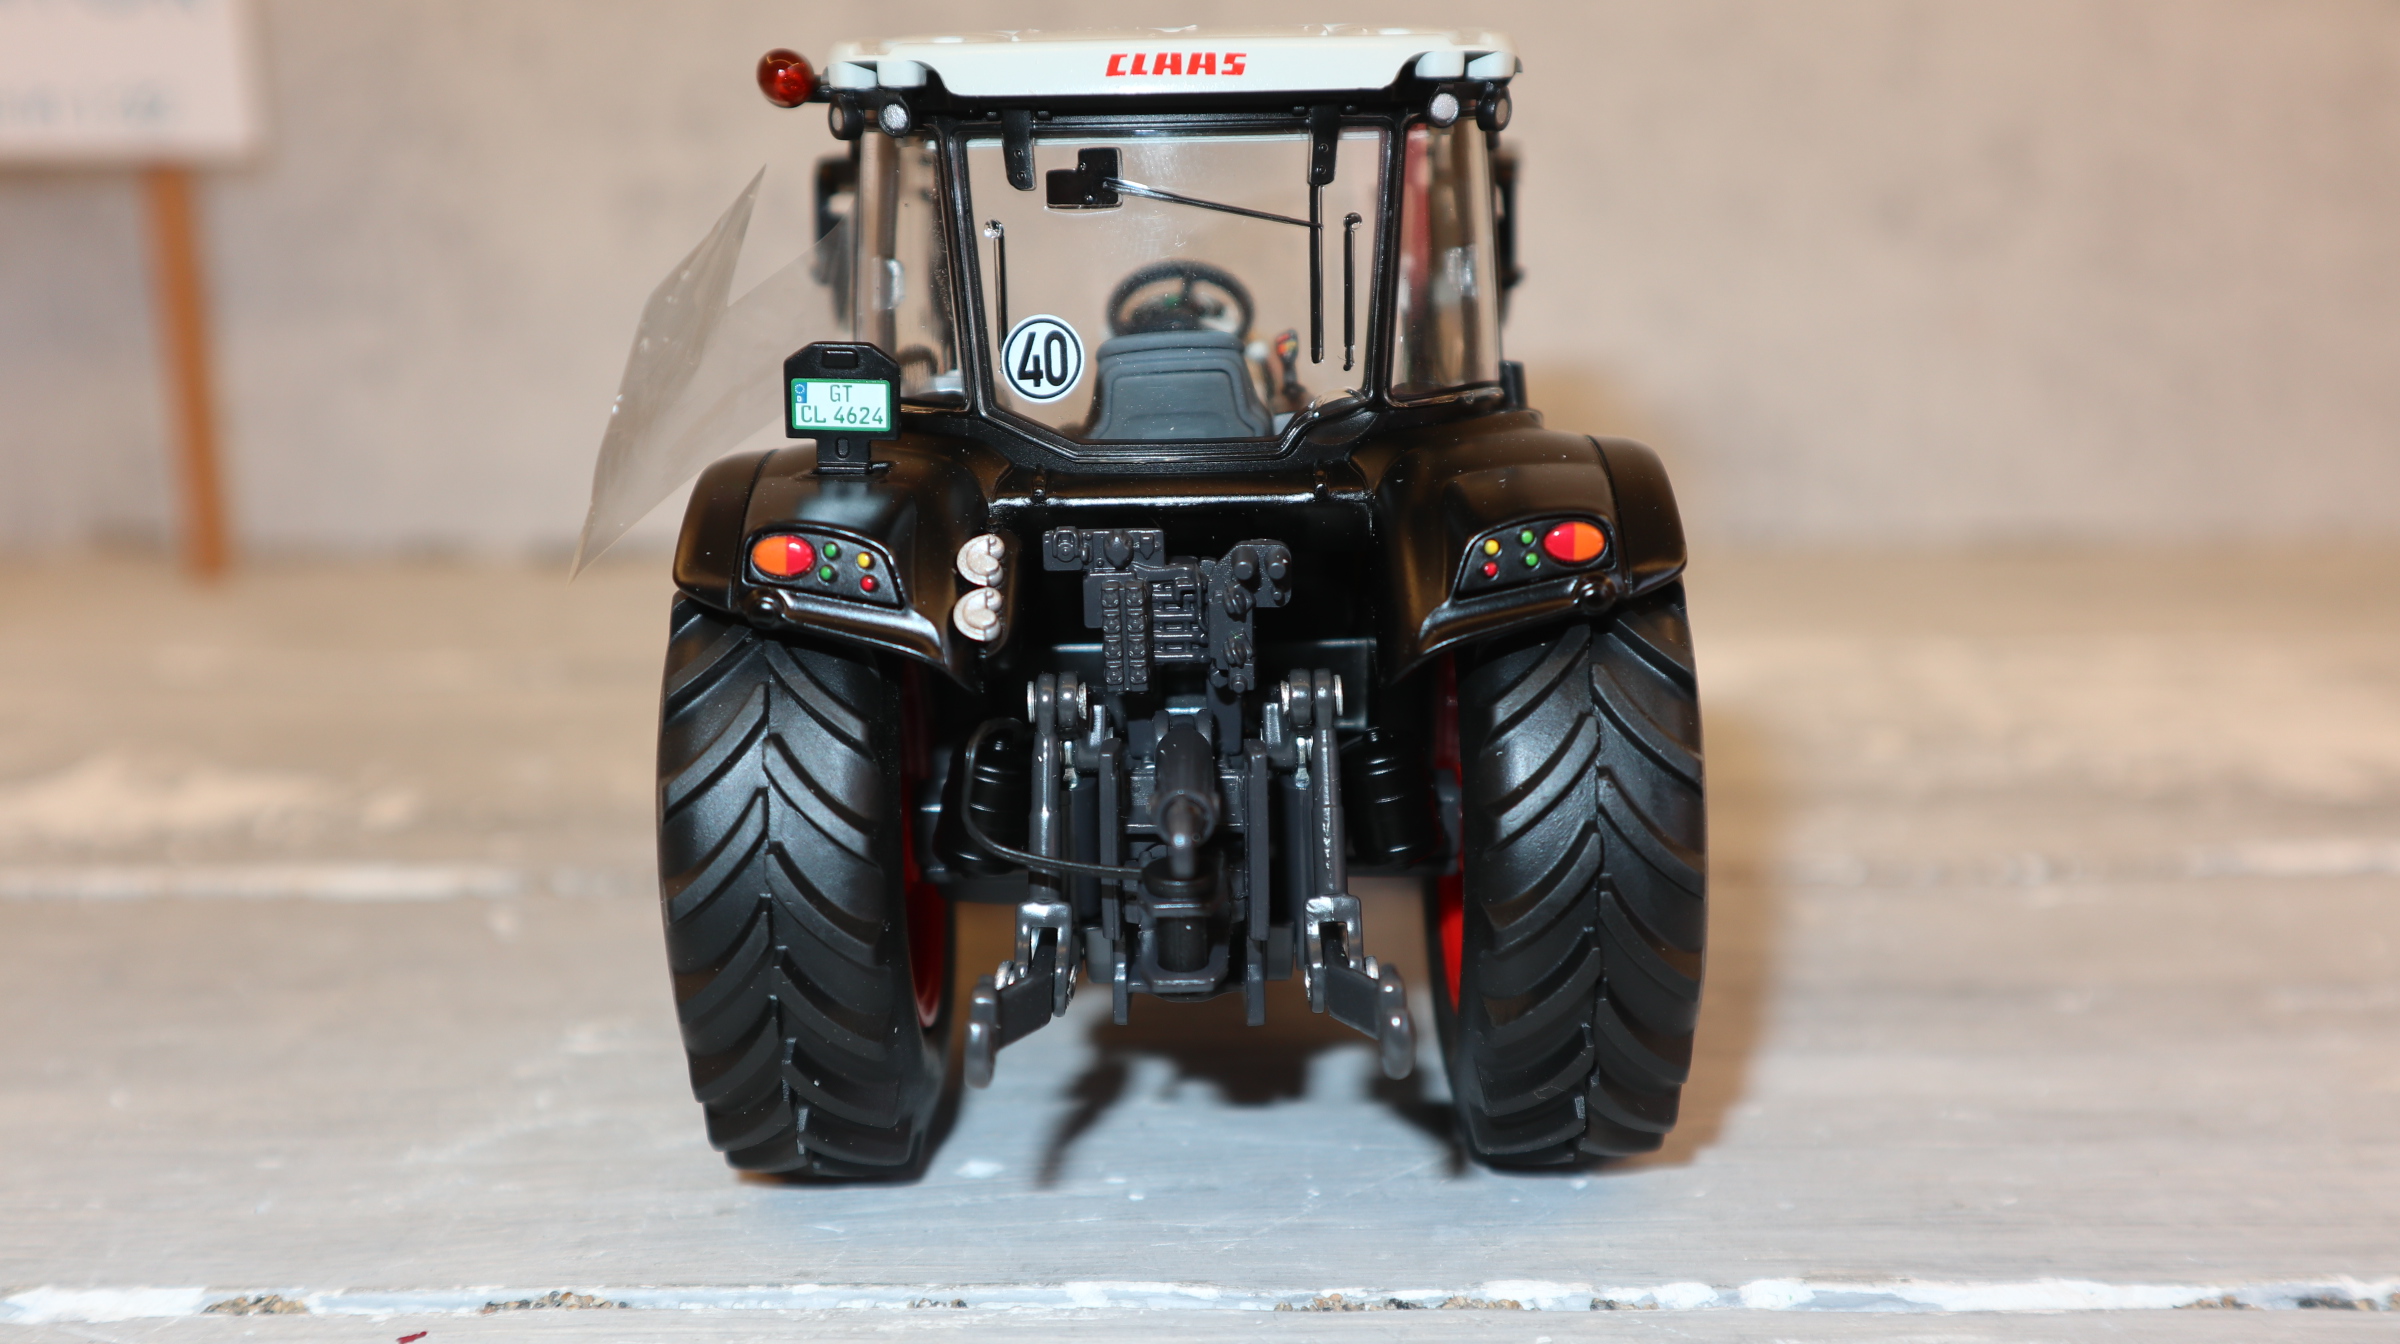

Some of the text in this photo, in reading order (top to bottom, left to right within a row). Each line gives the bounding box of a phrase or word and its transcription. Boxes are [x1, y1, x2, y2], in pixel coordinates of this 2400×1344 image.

[1105, 52, 1247, 77] CLAAS
[1017, 330, 1068, 387] 40
[830, 384, 853, 402] GT
[801, 405, 883, 425] CL 4624
